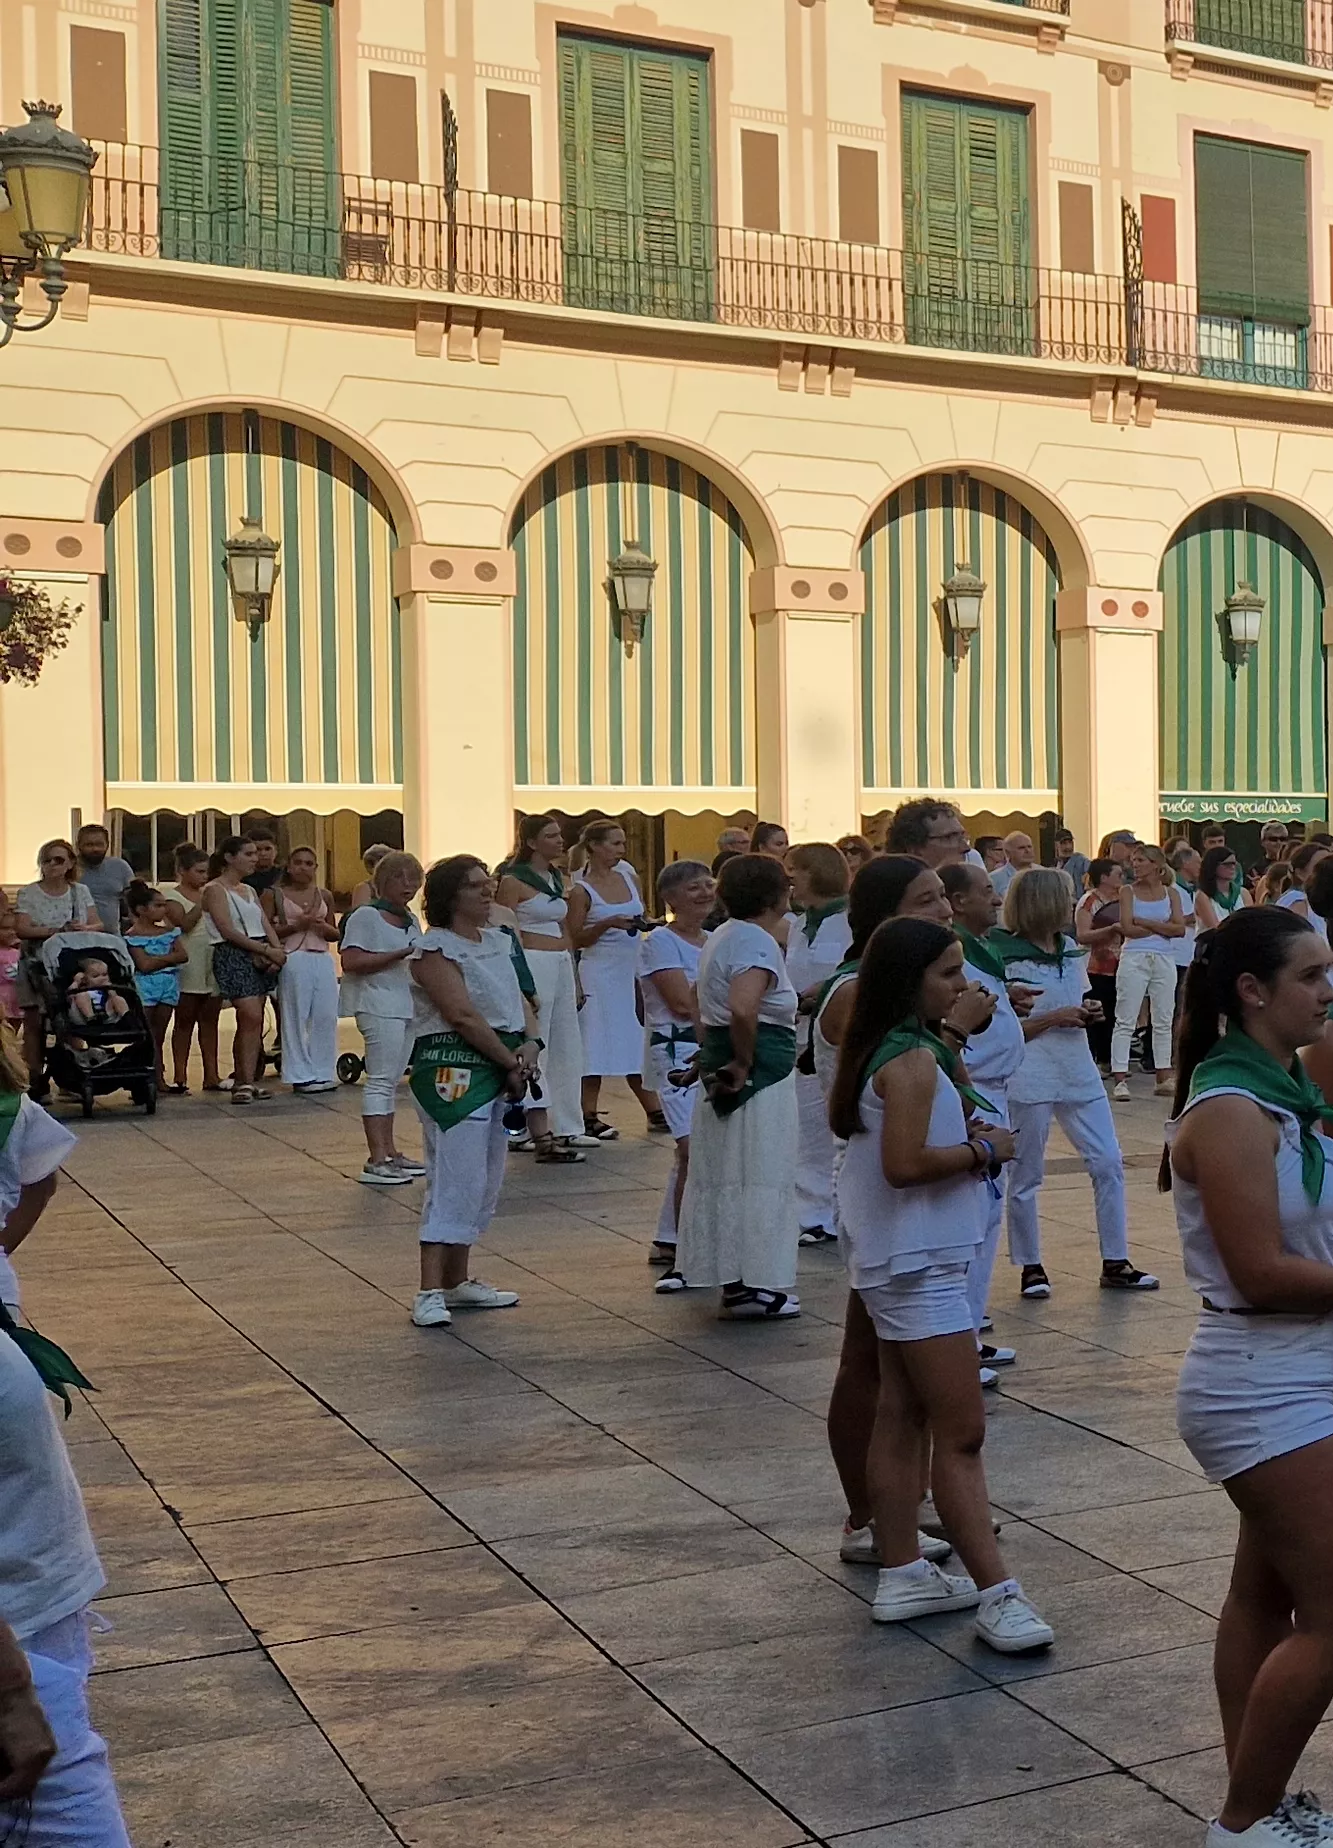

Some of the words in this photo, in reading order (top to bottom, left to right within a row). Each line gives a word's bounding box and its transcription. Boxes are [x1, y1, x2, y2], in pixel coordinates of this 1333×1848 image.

[1159, 799, 1195, 814] ruebe
[1200, 801, 1220, 813] sus
[1224, 799, 1302, 818] especialidades
